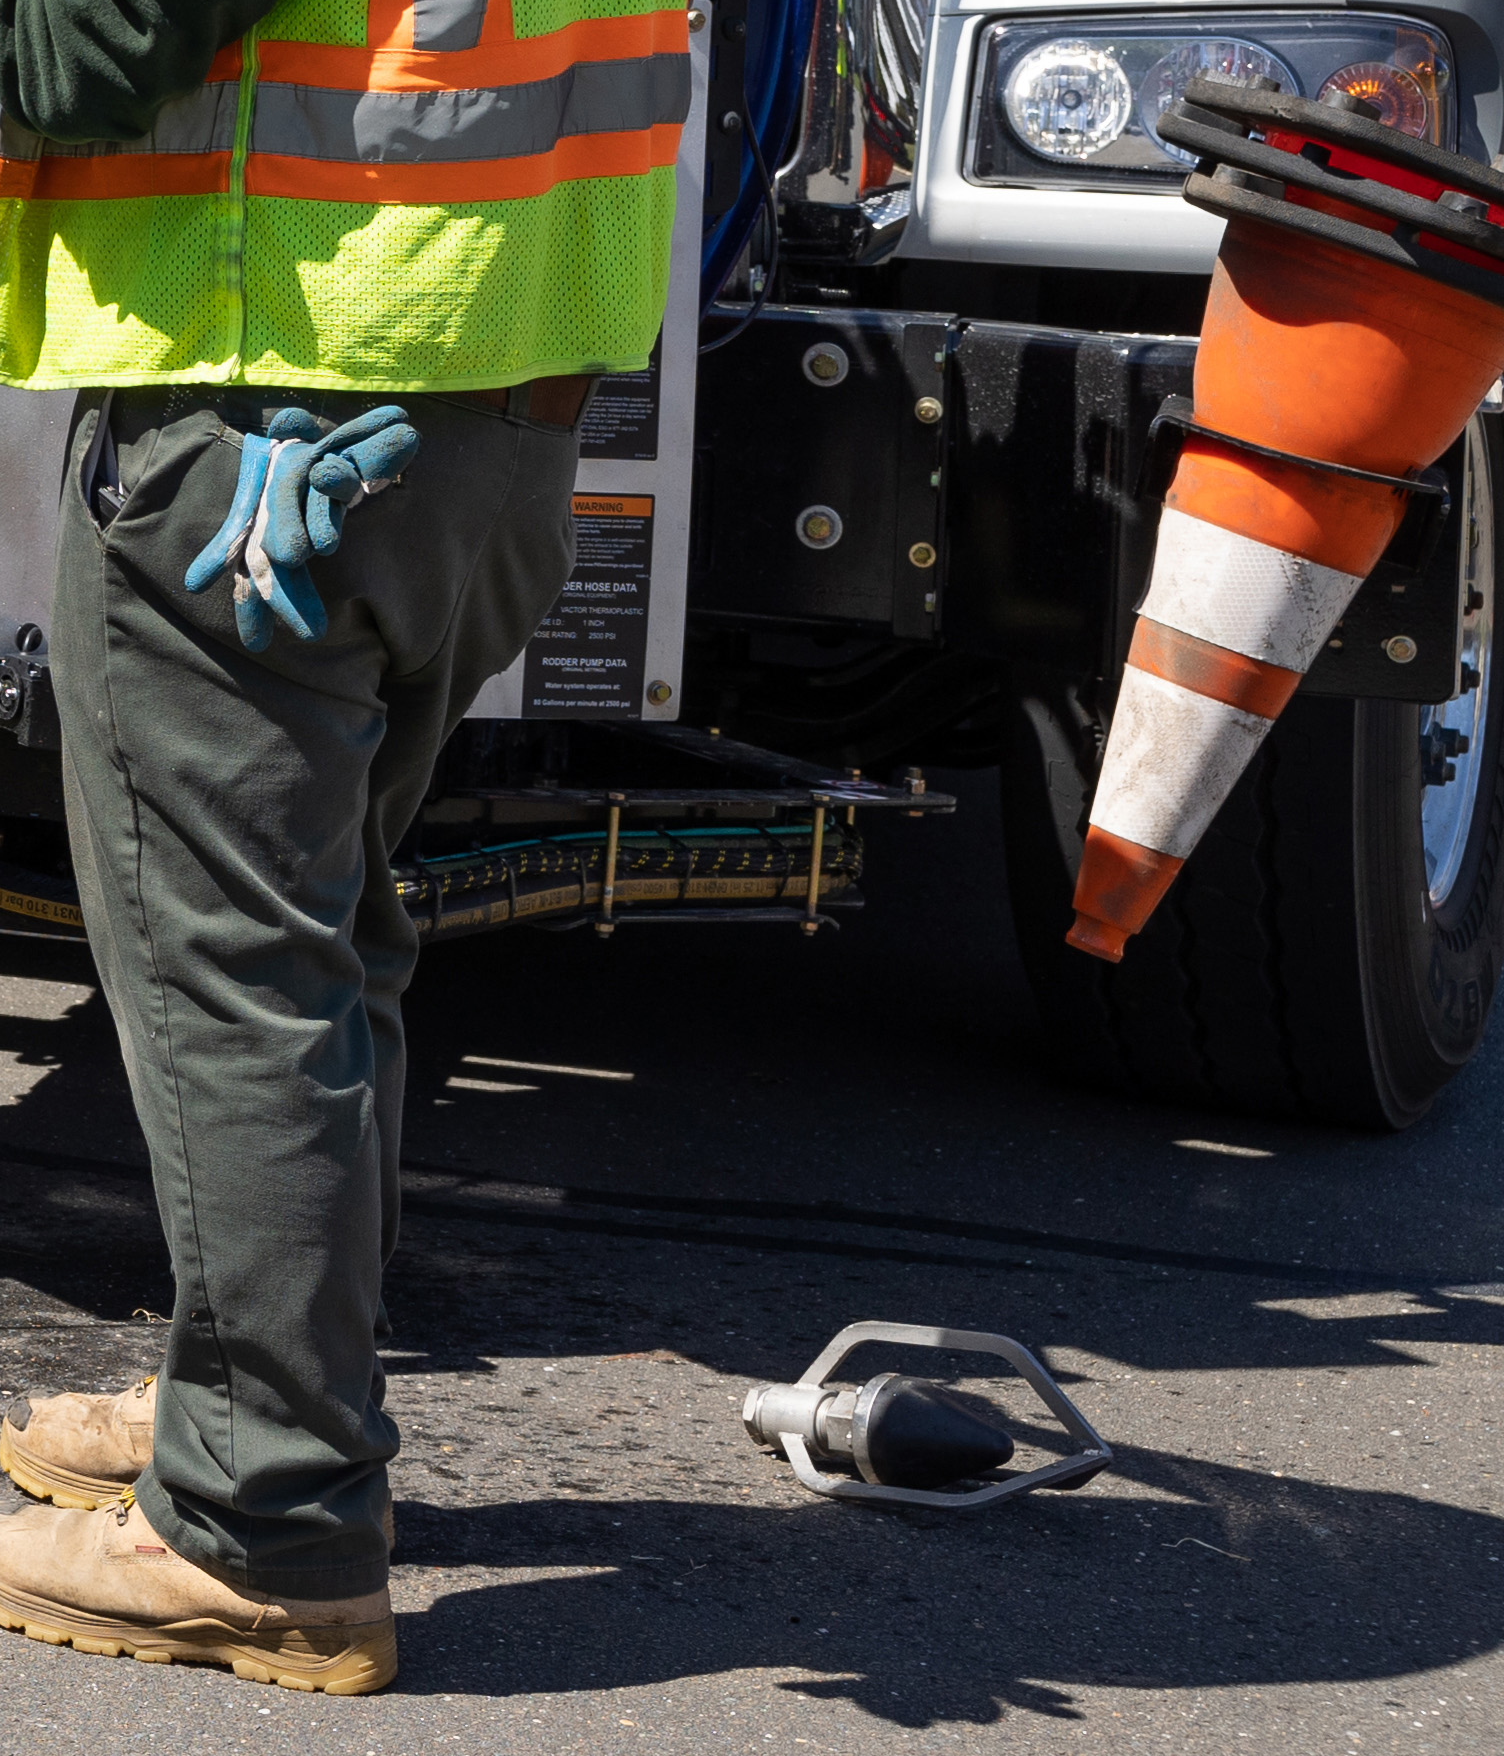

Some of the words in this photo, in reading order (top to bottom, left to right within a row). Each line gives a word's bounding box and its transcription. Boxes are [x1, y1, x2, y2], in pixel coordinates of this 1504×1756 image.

[574, 501, 624, 513] WARNING
[585, 582, 611, 592] HOSE
[613, 583, 638, 592] DATA
[560, 606, 588, 614] VACTOR
[589, 607, 644, 615] THERMOPLASTIC
[542, 657, 578, 666] RODDER
[580, 658, 604, 667] PUMP
[605, 658, 628, 668] DATA
[5, 895, 24, 909] bar
[26, 899, 49, 915] 310
